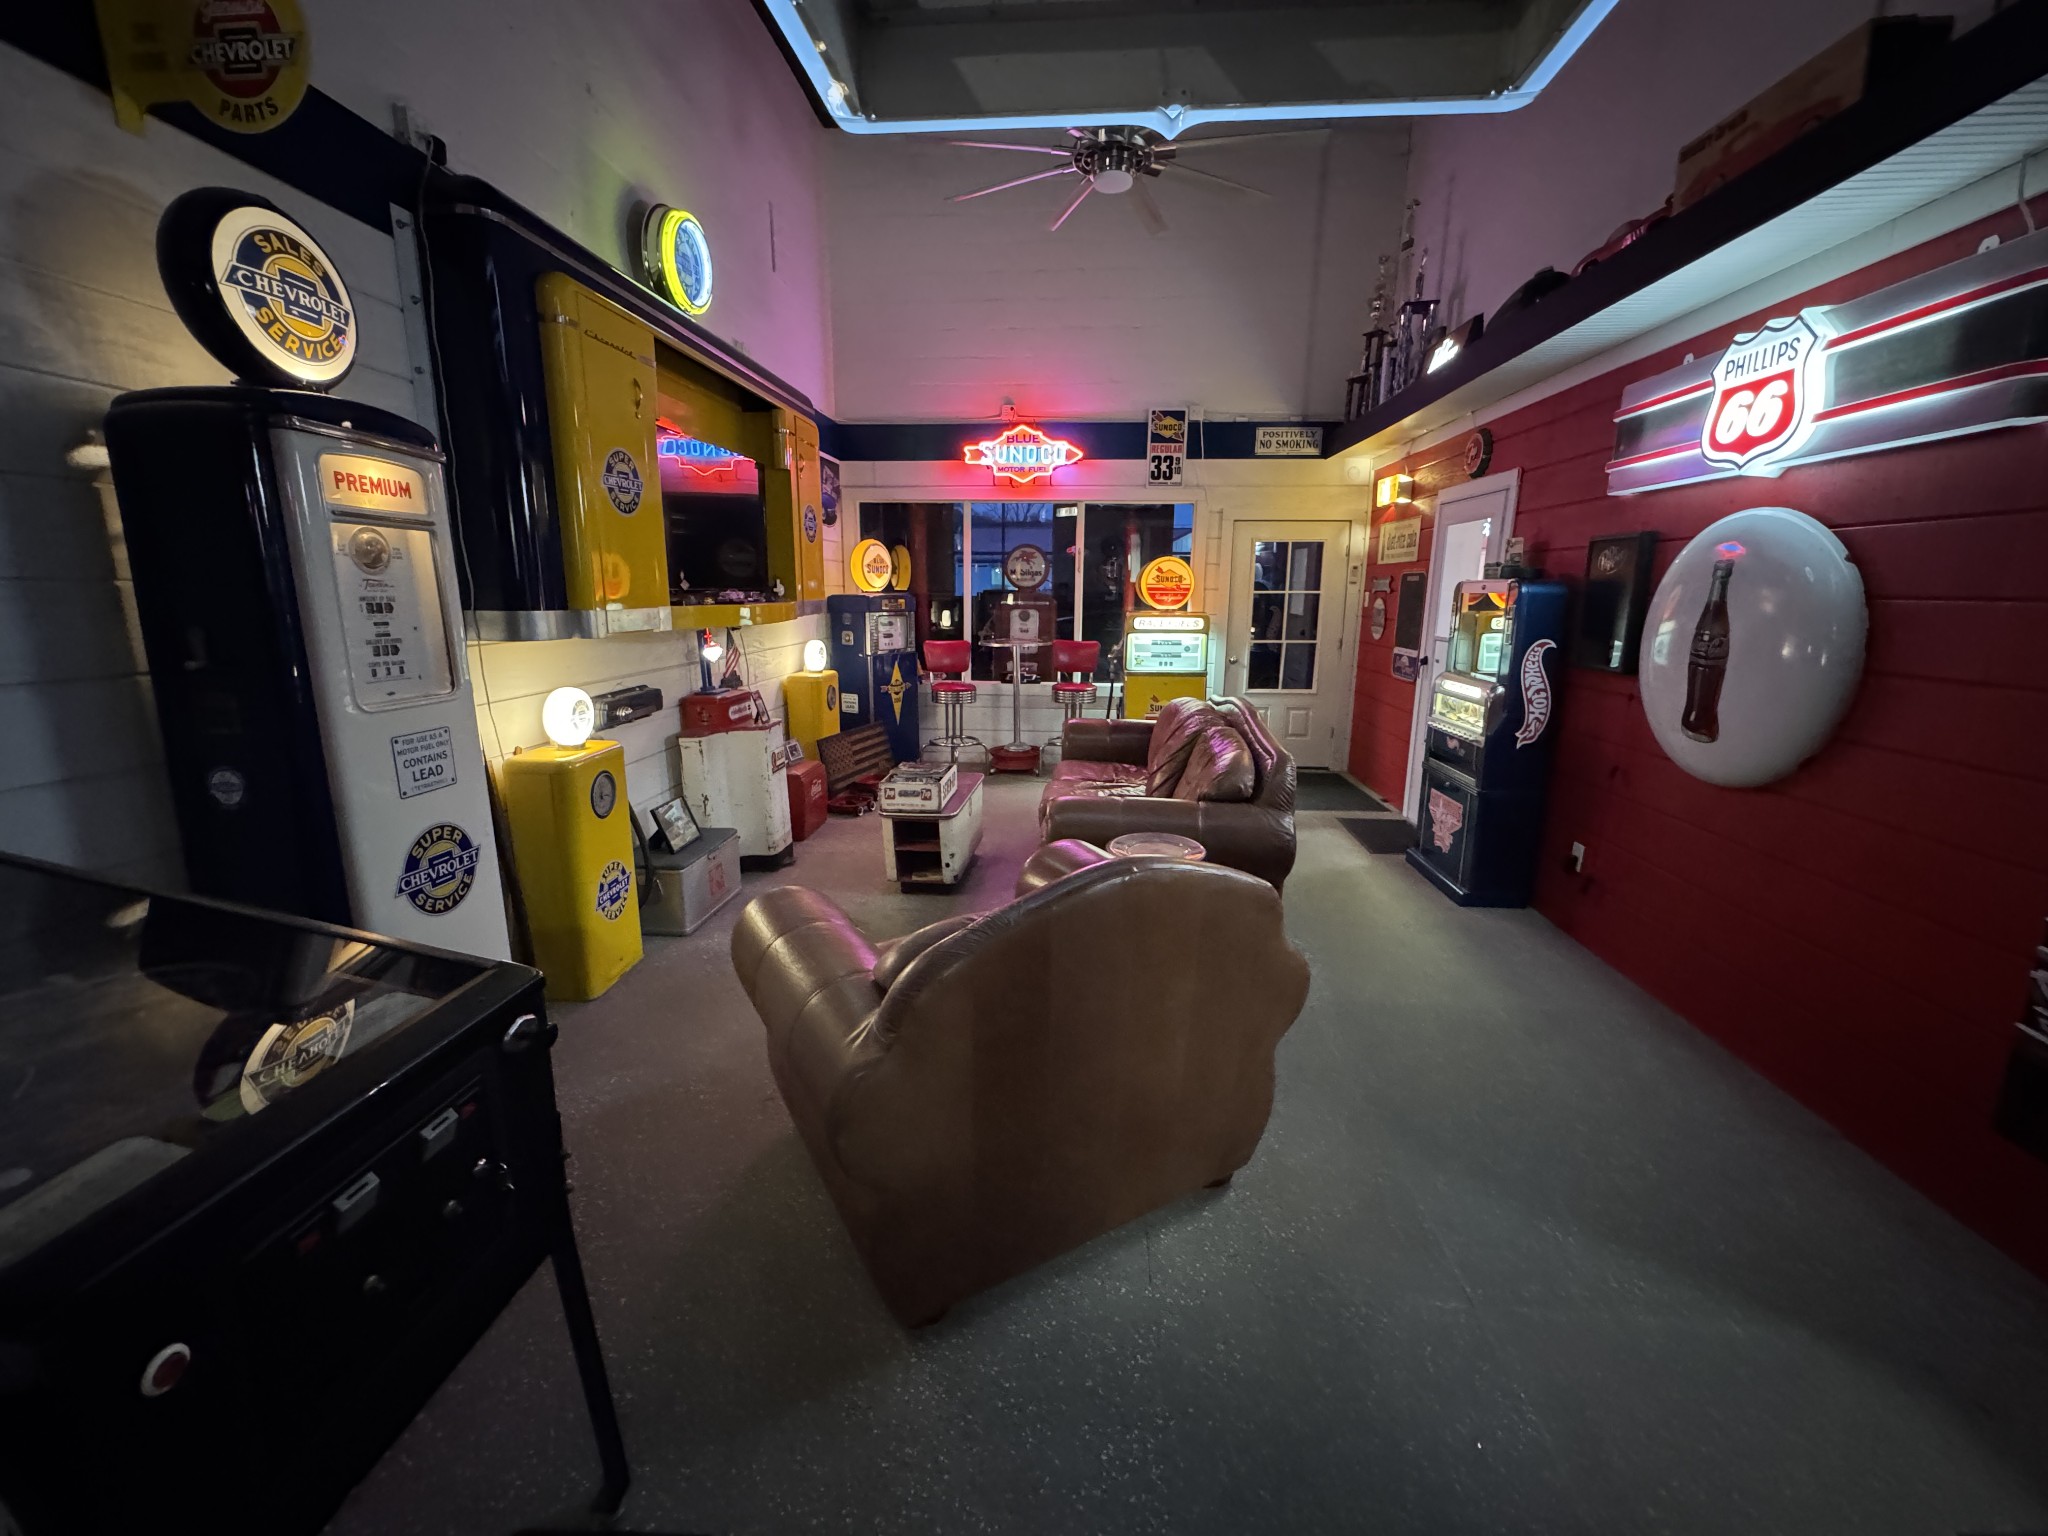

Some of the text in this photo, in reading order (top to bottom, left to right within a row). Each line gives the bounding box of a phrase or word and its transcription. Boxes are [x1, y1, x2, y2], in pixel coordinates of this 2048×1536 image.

[191, 38, 294, 64] CHEVROLET
[219, 97, 279, 124] PARTS
[253, 232, 326, 277] SALES
[236, 269, 347, 325] CHEVROLET
[256, 306, 341, 360] SERVICE
[1724, 336, 1801, 382] PHILLIPS
[1714, 379, 1789, 445] 66
[1154, 423, 1182, 432] SUNOCO
[1262, 430, 1318, 439] POSITIVELY
[1006, 434, 1040, 443] BLUE
[1259, 439, 1319, 450] NO SMOKING
[980, 443, 1067, 465] SUNOCO
[1151, 444, 1183, 454] REGULAR
[609, 454, 635, 471] SUPER
[1150, 455, 1181, 481] 33 9
[1174, 466, 1181, 475] 10
[333, 470, 412, 500] PREMIUM
[603, 474, 643, 491] CHEVROLET
[866, 563, 889, 574] SUNOCO
[1010, 568, 1042, 578] Mbilgas
[1155, 574, 1183, 583] SUNOCO
[396, 739, 449, 756] MOTOR FUEL ONLY
[402, 738, 415, 746] FOR
[416, 734, 428, 744] USE
[429, 732, 438, 741] AS
[403, 750, 448, 769] CONTAINS
[412, 764, 444, 783] LEAD
[412, 826, 463, 860] SUPER
[401, 850, 479, 891] CHEVROLET
[415, 872, 473, 912] SERVICE
[599, 878, 628, 905] CHEVROLET
